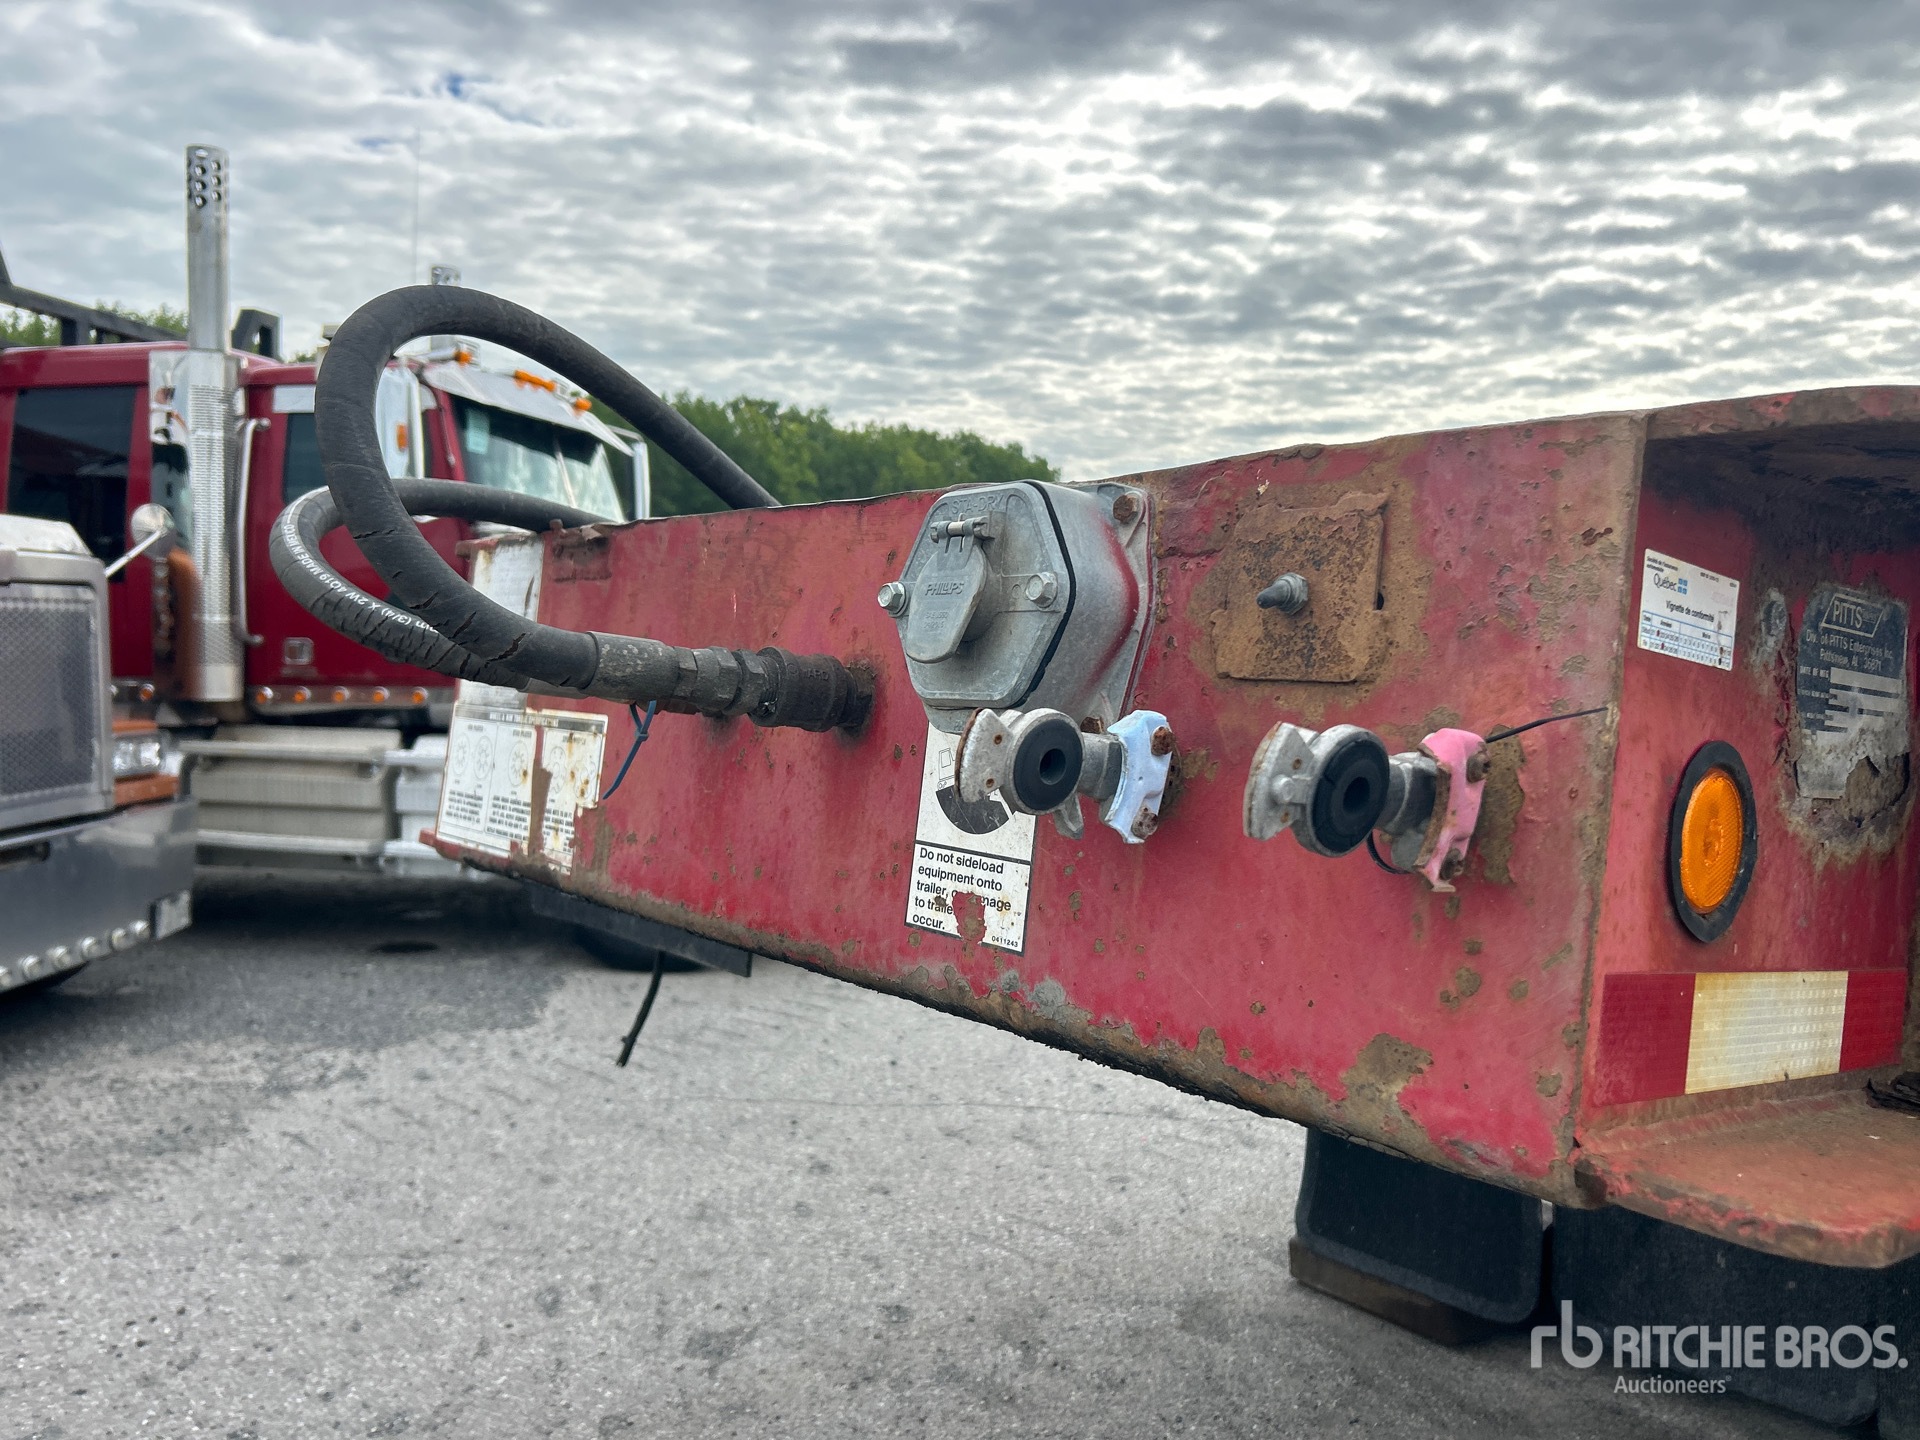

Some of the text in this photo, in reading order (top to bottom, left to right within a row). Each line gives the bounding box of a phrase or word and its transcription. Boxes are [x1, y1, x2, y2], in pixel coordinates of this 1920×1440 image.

[291, 541, 303, 556] IN
[298, 553, 324, 577] MADE
[924, 582, 965, 597] PHILLIPS
[1653, 573, 1677, 592] Québec
[346, 591, 369, 606] 2W
[369, 601, 381, 611] X
[380, 607, 412, 626] (3/4)
[1832, 600, 1863, 629] PITTS
[1829, 635, 1847, 649] PITTS
[920, 847, 1004, 874] Do not sideload
[918, 865, 1002, 892] equipment onto
[914, 896, 953, 915] to traile
[916, 880, 949, 898] trailer,
[982, 895, 1012, 912] mage
[912, 914, 945, 930] occur.
[991, 935, 1019, 948] 0411243
